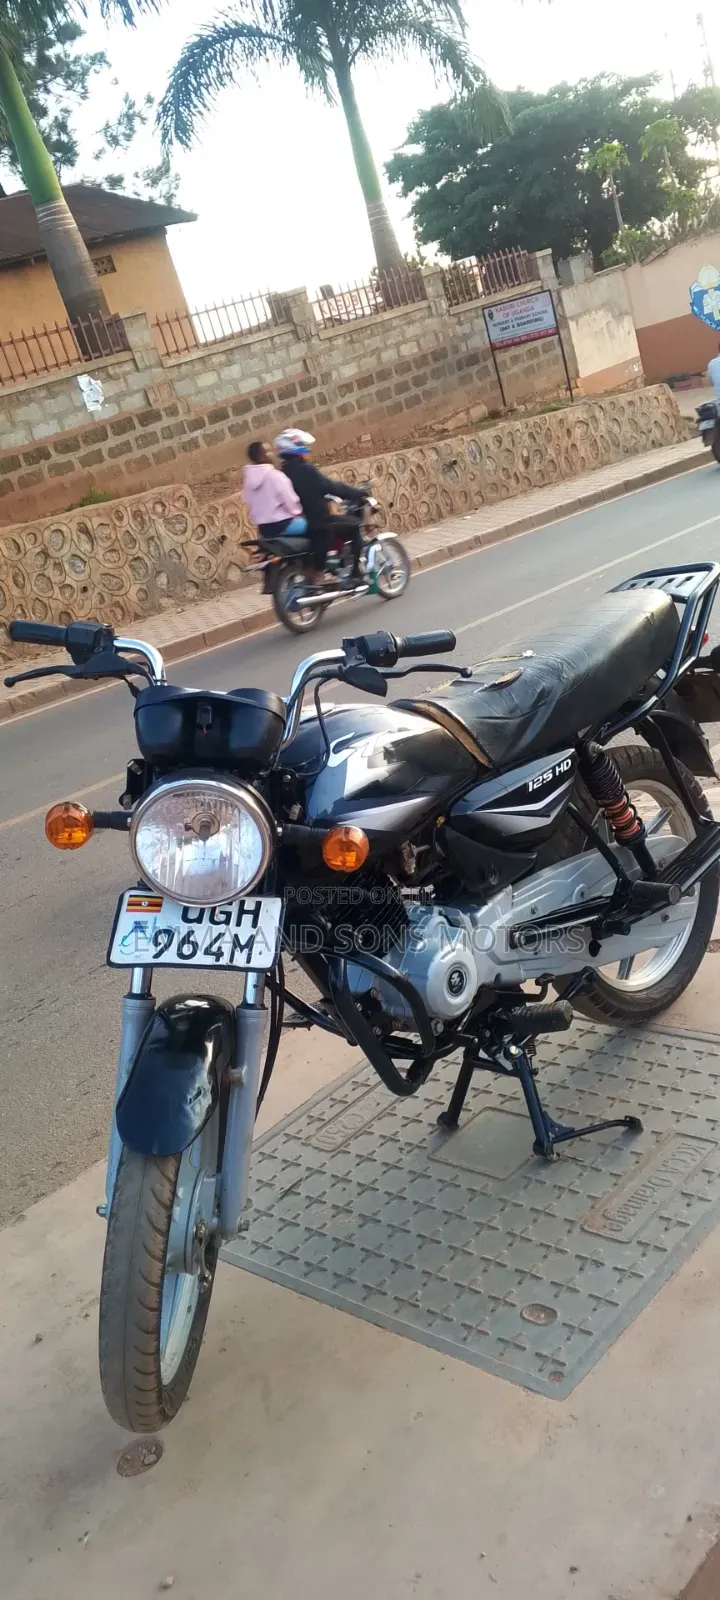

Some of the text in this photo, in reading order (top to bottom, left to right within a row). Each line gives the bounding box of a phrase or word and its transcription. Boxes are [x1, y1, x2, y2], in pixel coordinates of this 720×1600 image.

[512, 306, 535, 316] UGANDA
[516, 297, 539, 308] CHURCH
[532, 309, 548, 317] SCHOOL
[528, 758, 572, 792] 125 HD
[152, 928, 256, 964] 964M
[602, 1142, 706, 1232] KCCA Drainage
